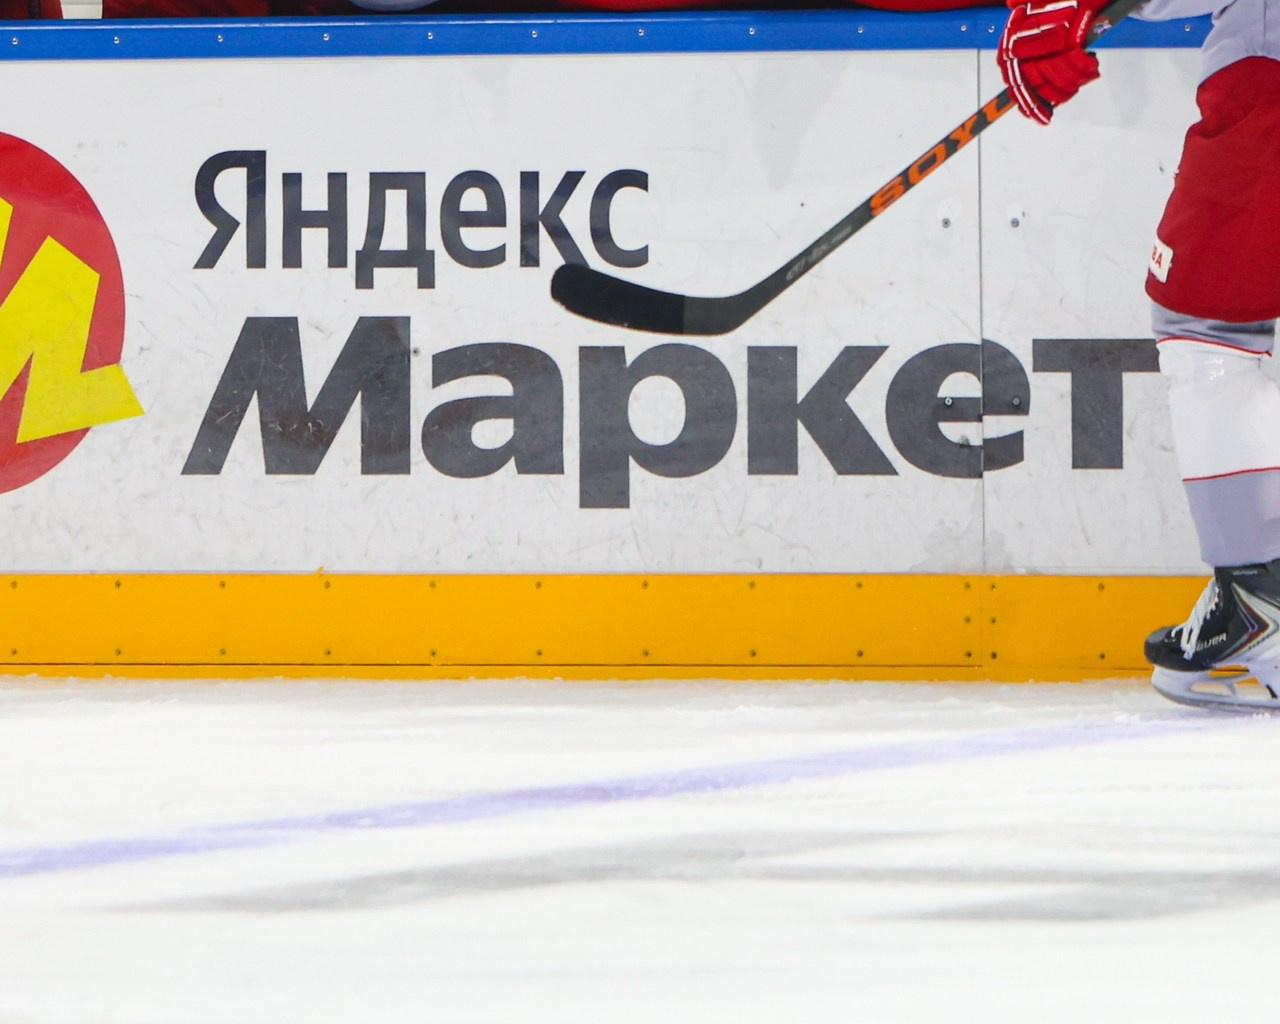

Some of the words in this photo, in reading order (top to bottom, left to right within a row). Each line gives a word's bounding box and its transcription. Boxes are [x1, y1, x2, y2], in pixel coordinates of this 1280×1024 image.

[193, 149, 649, 290] Яндекс
[181, 316, 1160, 509] Маркет
[1196, 632, 1228, 652] AUER
